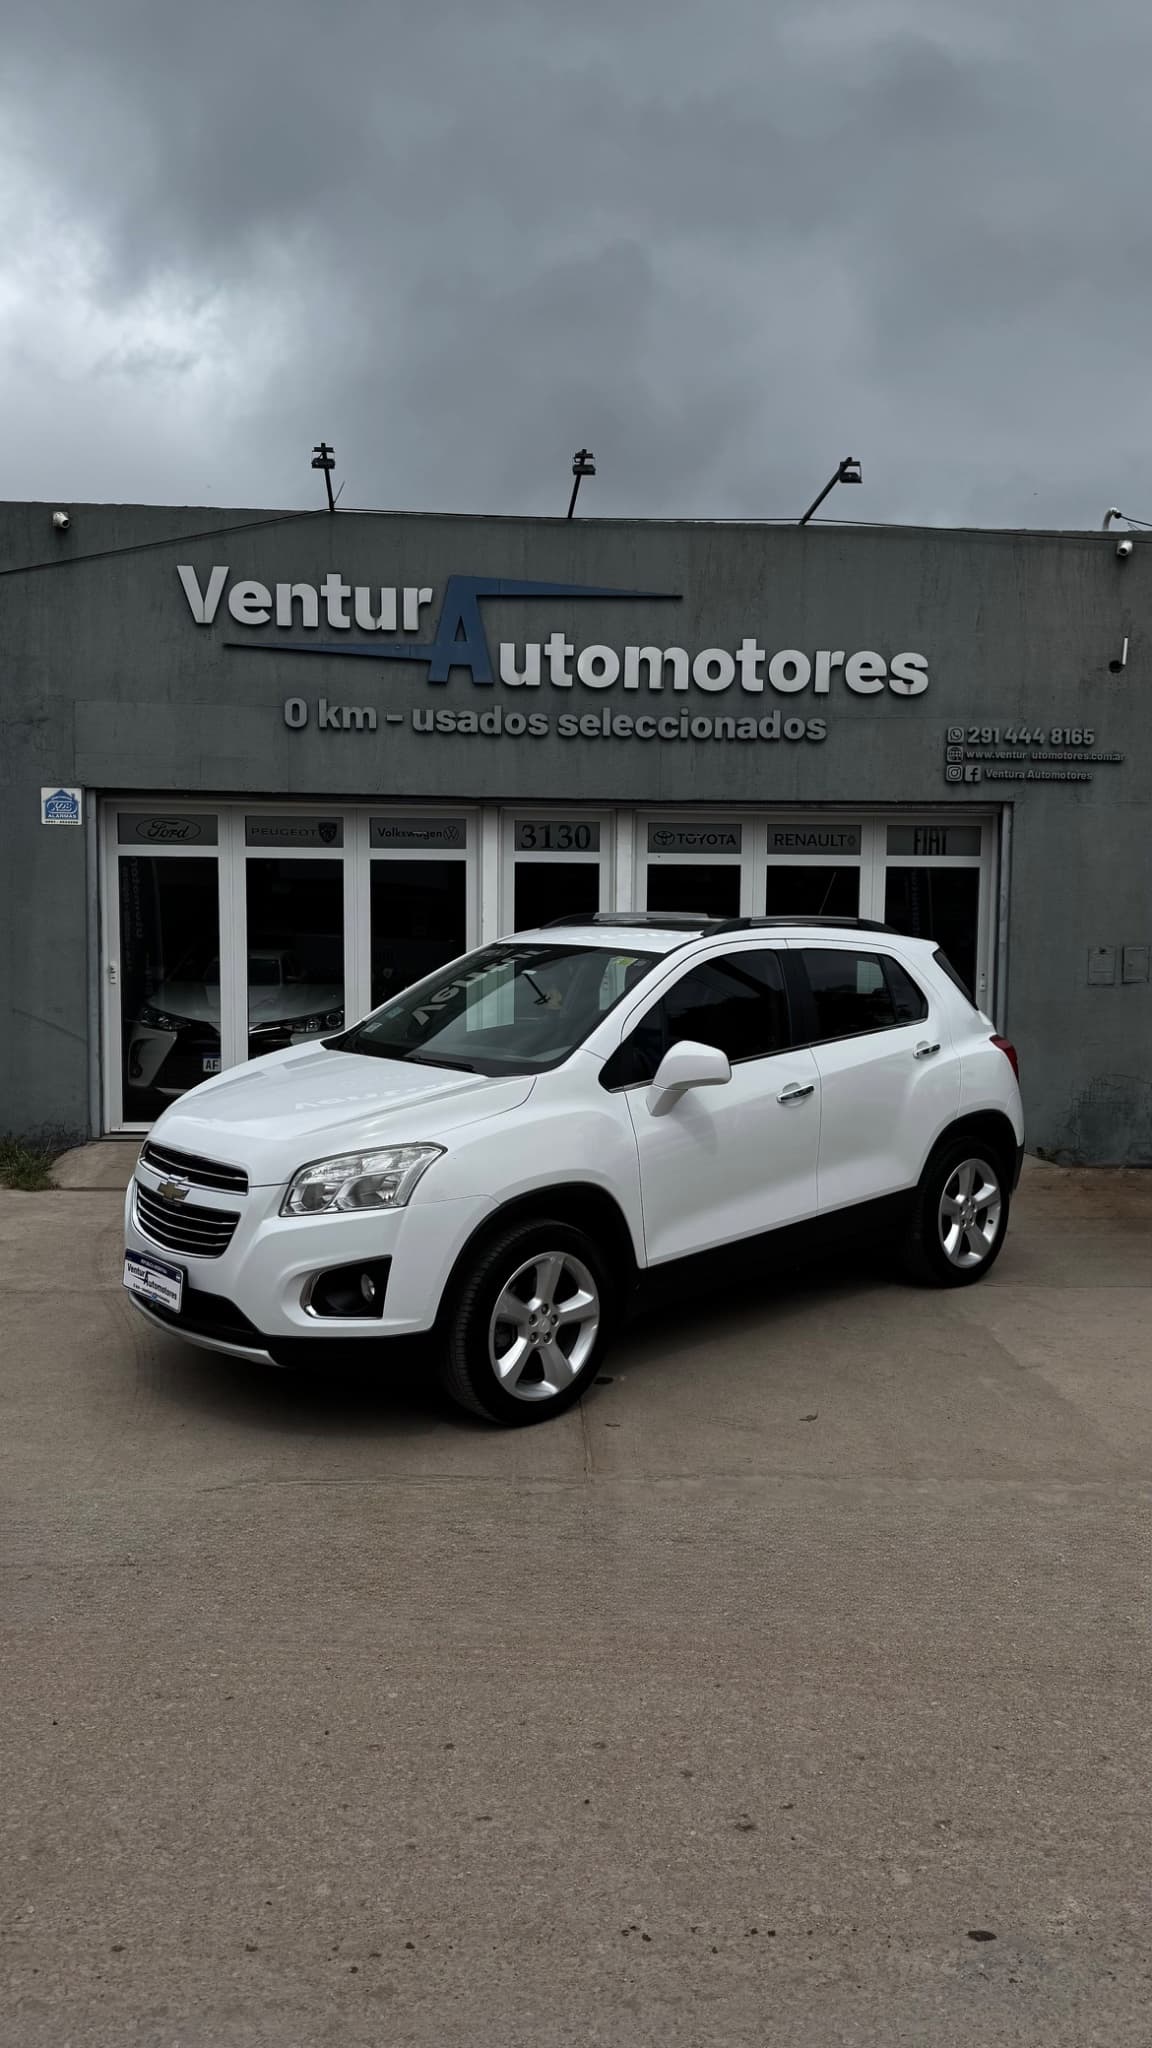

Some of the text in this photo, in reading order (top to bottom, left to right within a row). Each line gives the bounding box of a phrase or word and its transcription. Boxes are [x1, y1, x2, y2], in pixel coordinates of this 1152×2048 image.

[284, 698, 308, 728] 0
[318, 699, 377, 729] km
[412, 705, 549, 736] usados
[557, 708, 828, 741] seleccionados
[967, 726, 1095, 745] 291 444 8165
[985, 768, 1093, 781] Ventura Automotores
[147, 819, 191, 840] Ford
[251, 826, 318, 837] PEUGEOT
[377, 827, 443, 841] Volkswagen
[520, 823, 592, 850] 3130
[676, 833, 737, 845] TOYOTA
[773, 833, 847, 847] RENAULT
[913, 826, 950, 855] FIAT
